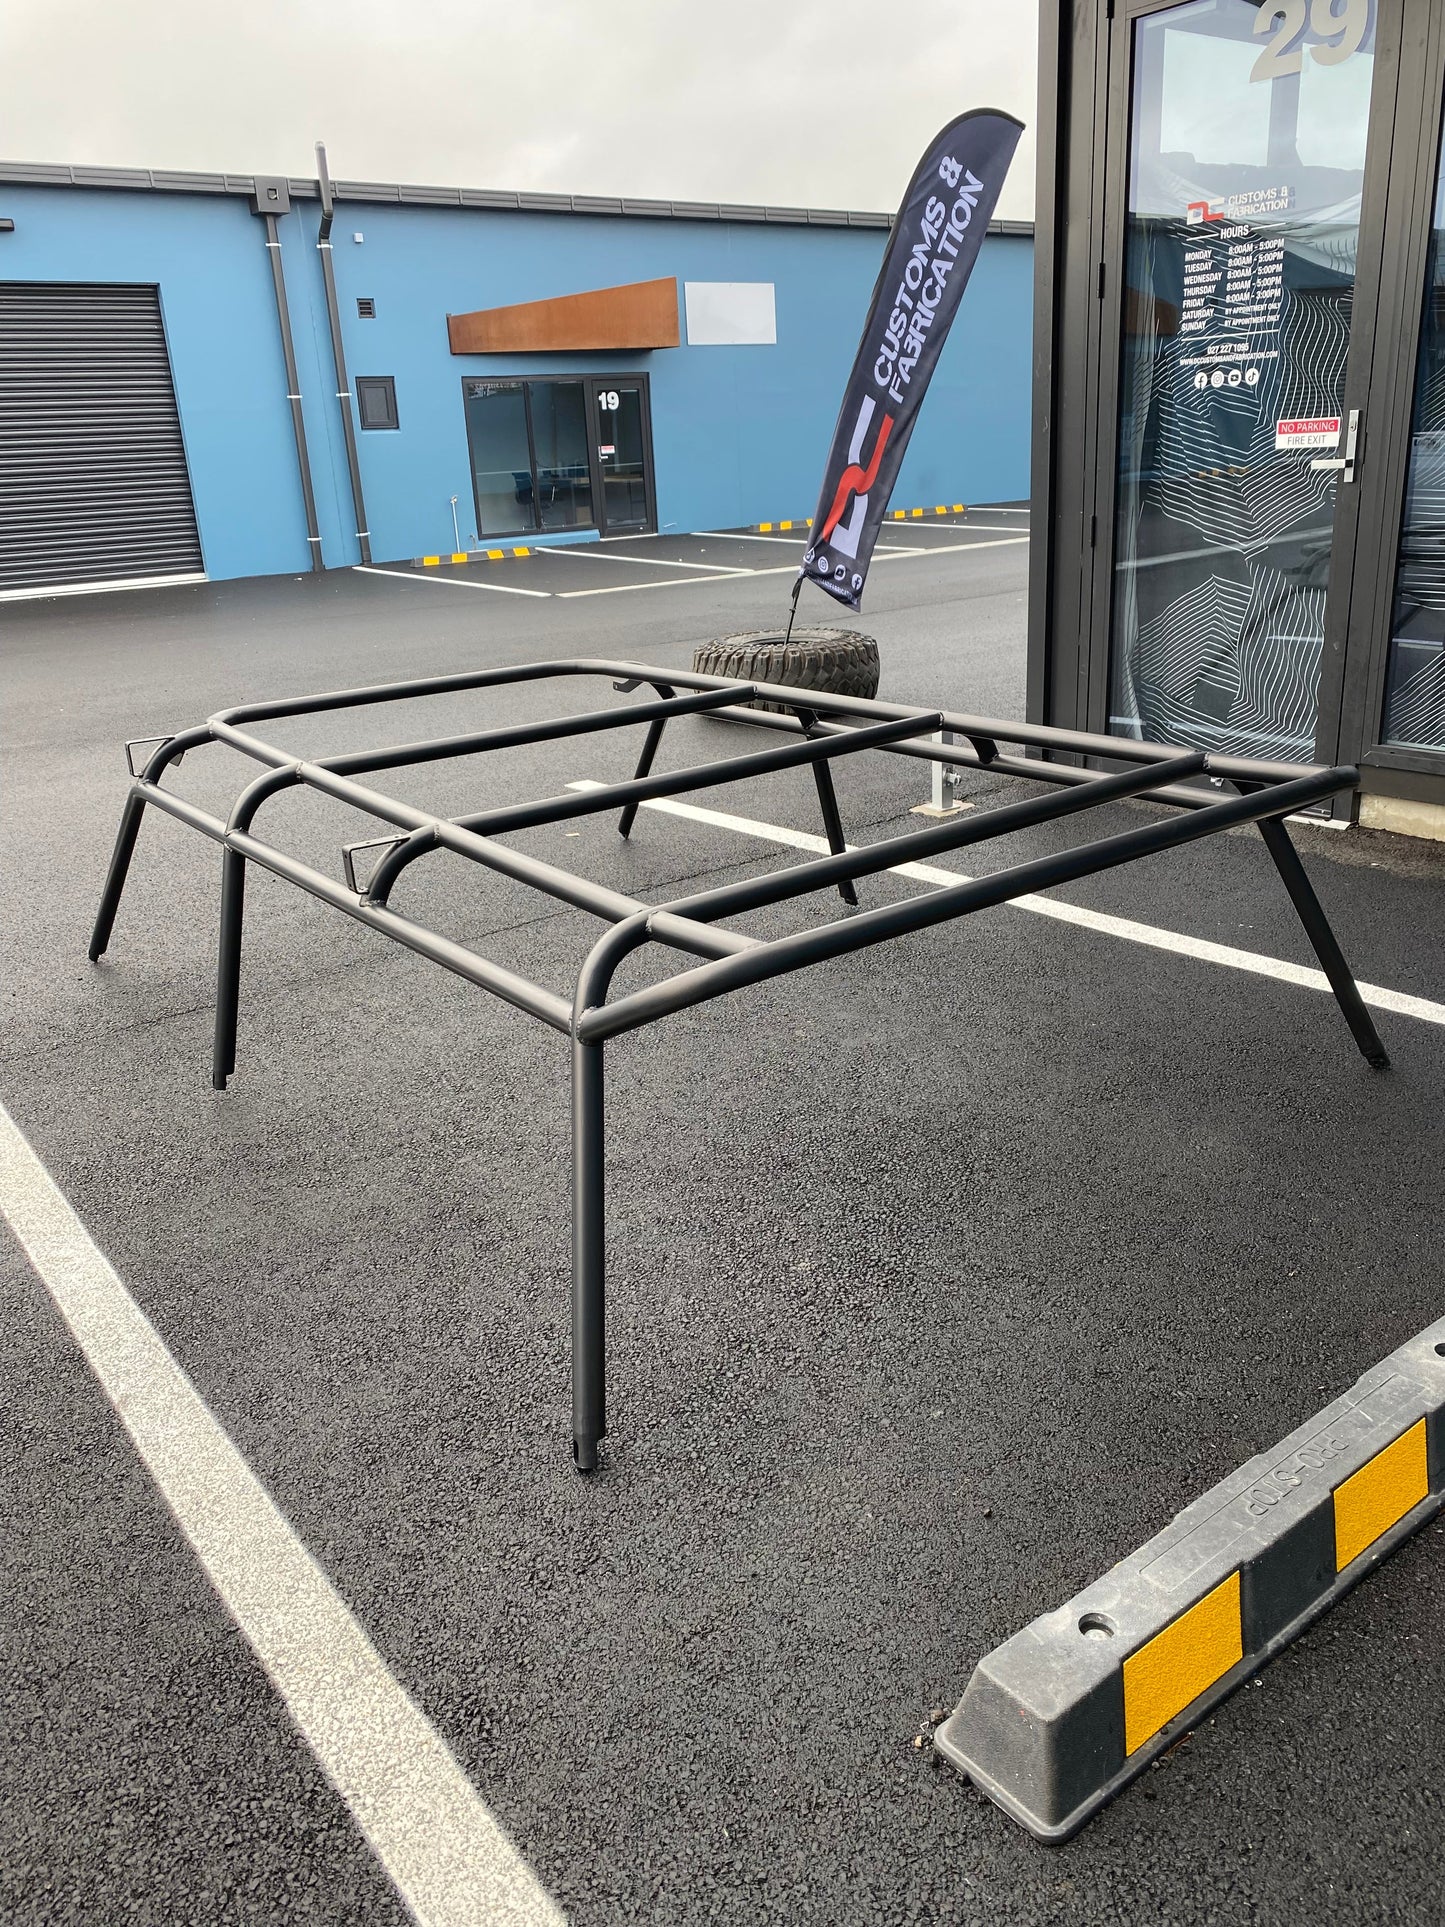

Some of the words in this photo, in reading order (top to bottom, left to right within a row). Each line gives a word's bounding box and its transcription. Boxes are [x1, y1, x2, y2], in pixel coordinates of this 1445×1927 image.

[1249, 0, 1368, 83] 29
[1228, 187, 1277, 206] CUSTOMS
[1227, 198, 1288, 218] FABRICATION
[1220, 225, 1249, 240] HOURS
[1185, 249, 1212, 262] MONDAY
[1228, 243, 1253, 255] 8:00AM
[1259, 238, 1284, 250] 5:00PM
[873, 195, 946, 387] CUSTOMS
[938, 155, 963, 188] &
[1184, 261, 1213, 273] TUESDAY
[1227, 255, 1252, 267] 8:00AM
[1259, 251, 1284, 261] 5:00PM
[1184, 272, 1222, 285] WEDNESDAY
[1227, 267, 1252, 279] 8:00AM
[1258, 263, 1283, 275] 5:00PM
[888, 169, 984, 404] FABRICATION
[1183, 285, 1216, 297] THURSDAY
[1226, 280, 1251, 291] 8:00AM
[1257, 276, 1282, 287] 5:00PM
[1183, 298, 1205, 308] FRIDAY
[1225, 292, 1250, 303] 8:00AM
[1256, 288, 1281, 299] 3:00PM
[1182, 308, 1214, 320] SATURDAY
[1232, 304, 1267, 314] APPOINTMENT
[1268, 302, 1281, 310] ONLY
[1181, 320, 1206, 331] SUNDAY
[1232, 316, 1266, 326] APPOINTMENT
[1267, 314, 1280, 322] ONLY
[1207, 346, 1219, 354] 027
[1220, 344, 1232, 353] 227
[598, 391, 620, 410] 19
[1281, 423, 1295, 433] NO
[1296, 421, 1335, 432] PARKING
[1287, 436, 1305, 445] FIRE
[1307, 435, 1327, 445] EXIT
[1246, 1433, 1349, 1516] PRO-STOP
